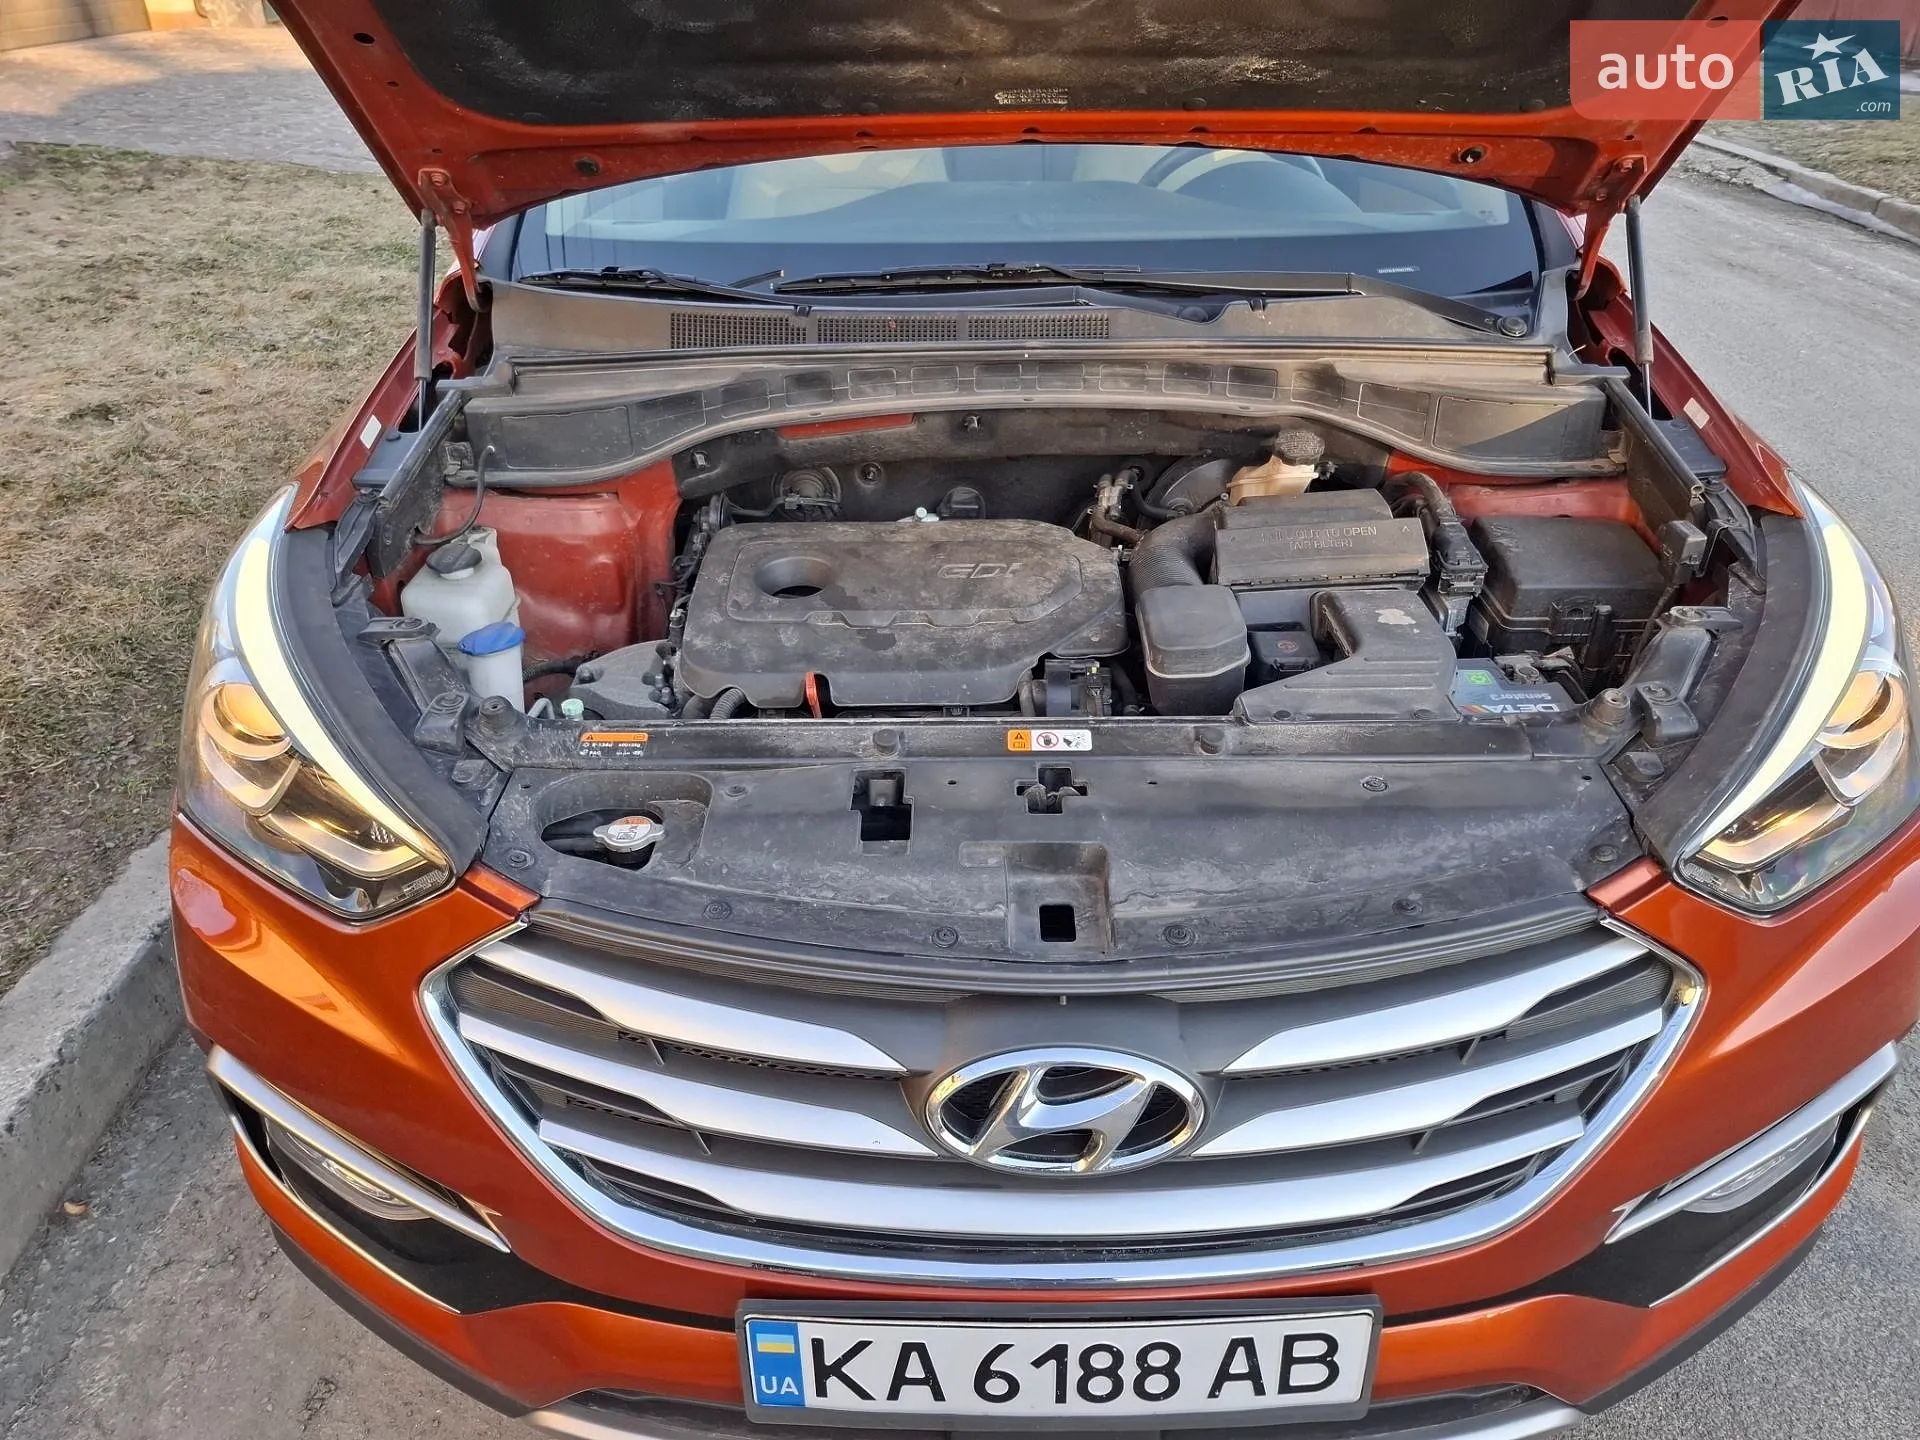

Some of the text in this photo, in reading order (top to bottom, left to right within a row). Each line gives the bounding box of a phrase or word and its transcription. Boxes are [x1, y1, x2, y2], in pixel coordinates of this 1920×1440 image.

[1343, 525, 1377, 538] OPEN
[937, 562, 1023, 579] GDI
[1481, 703, 1561, 713] DETA
[810, 1332, 1341, 1404] KA 6188 AB
[760, 1375, 799, 1396] UA
